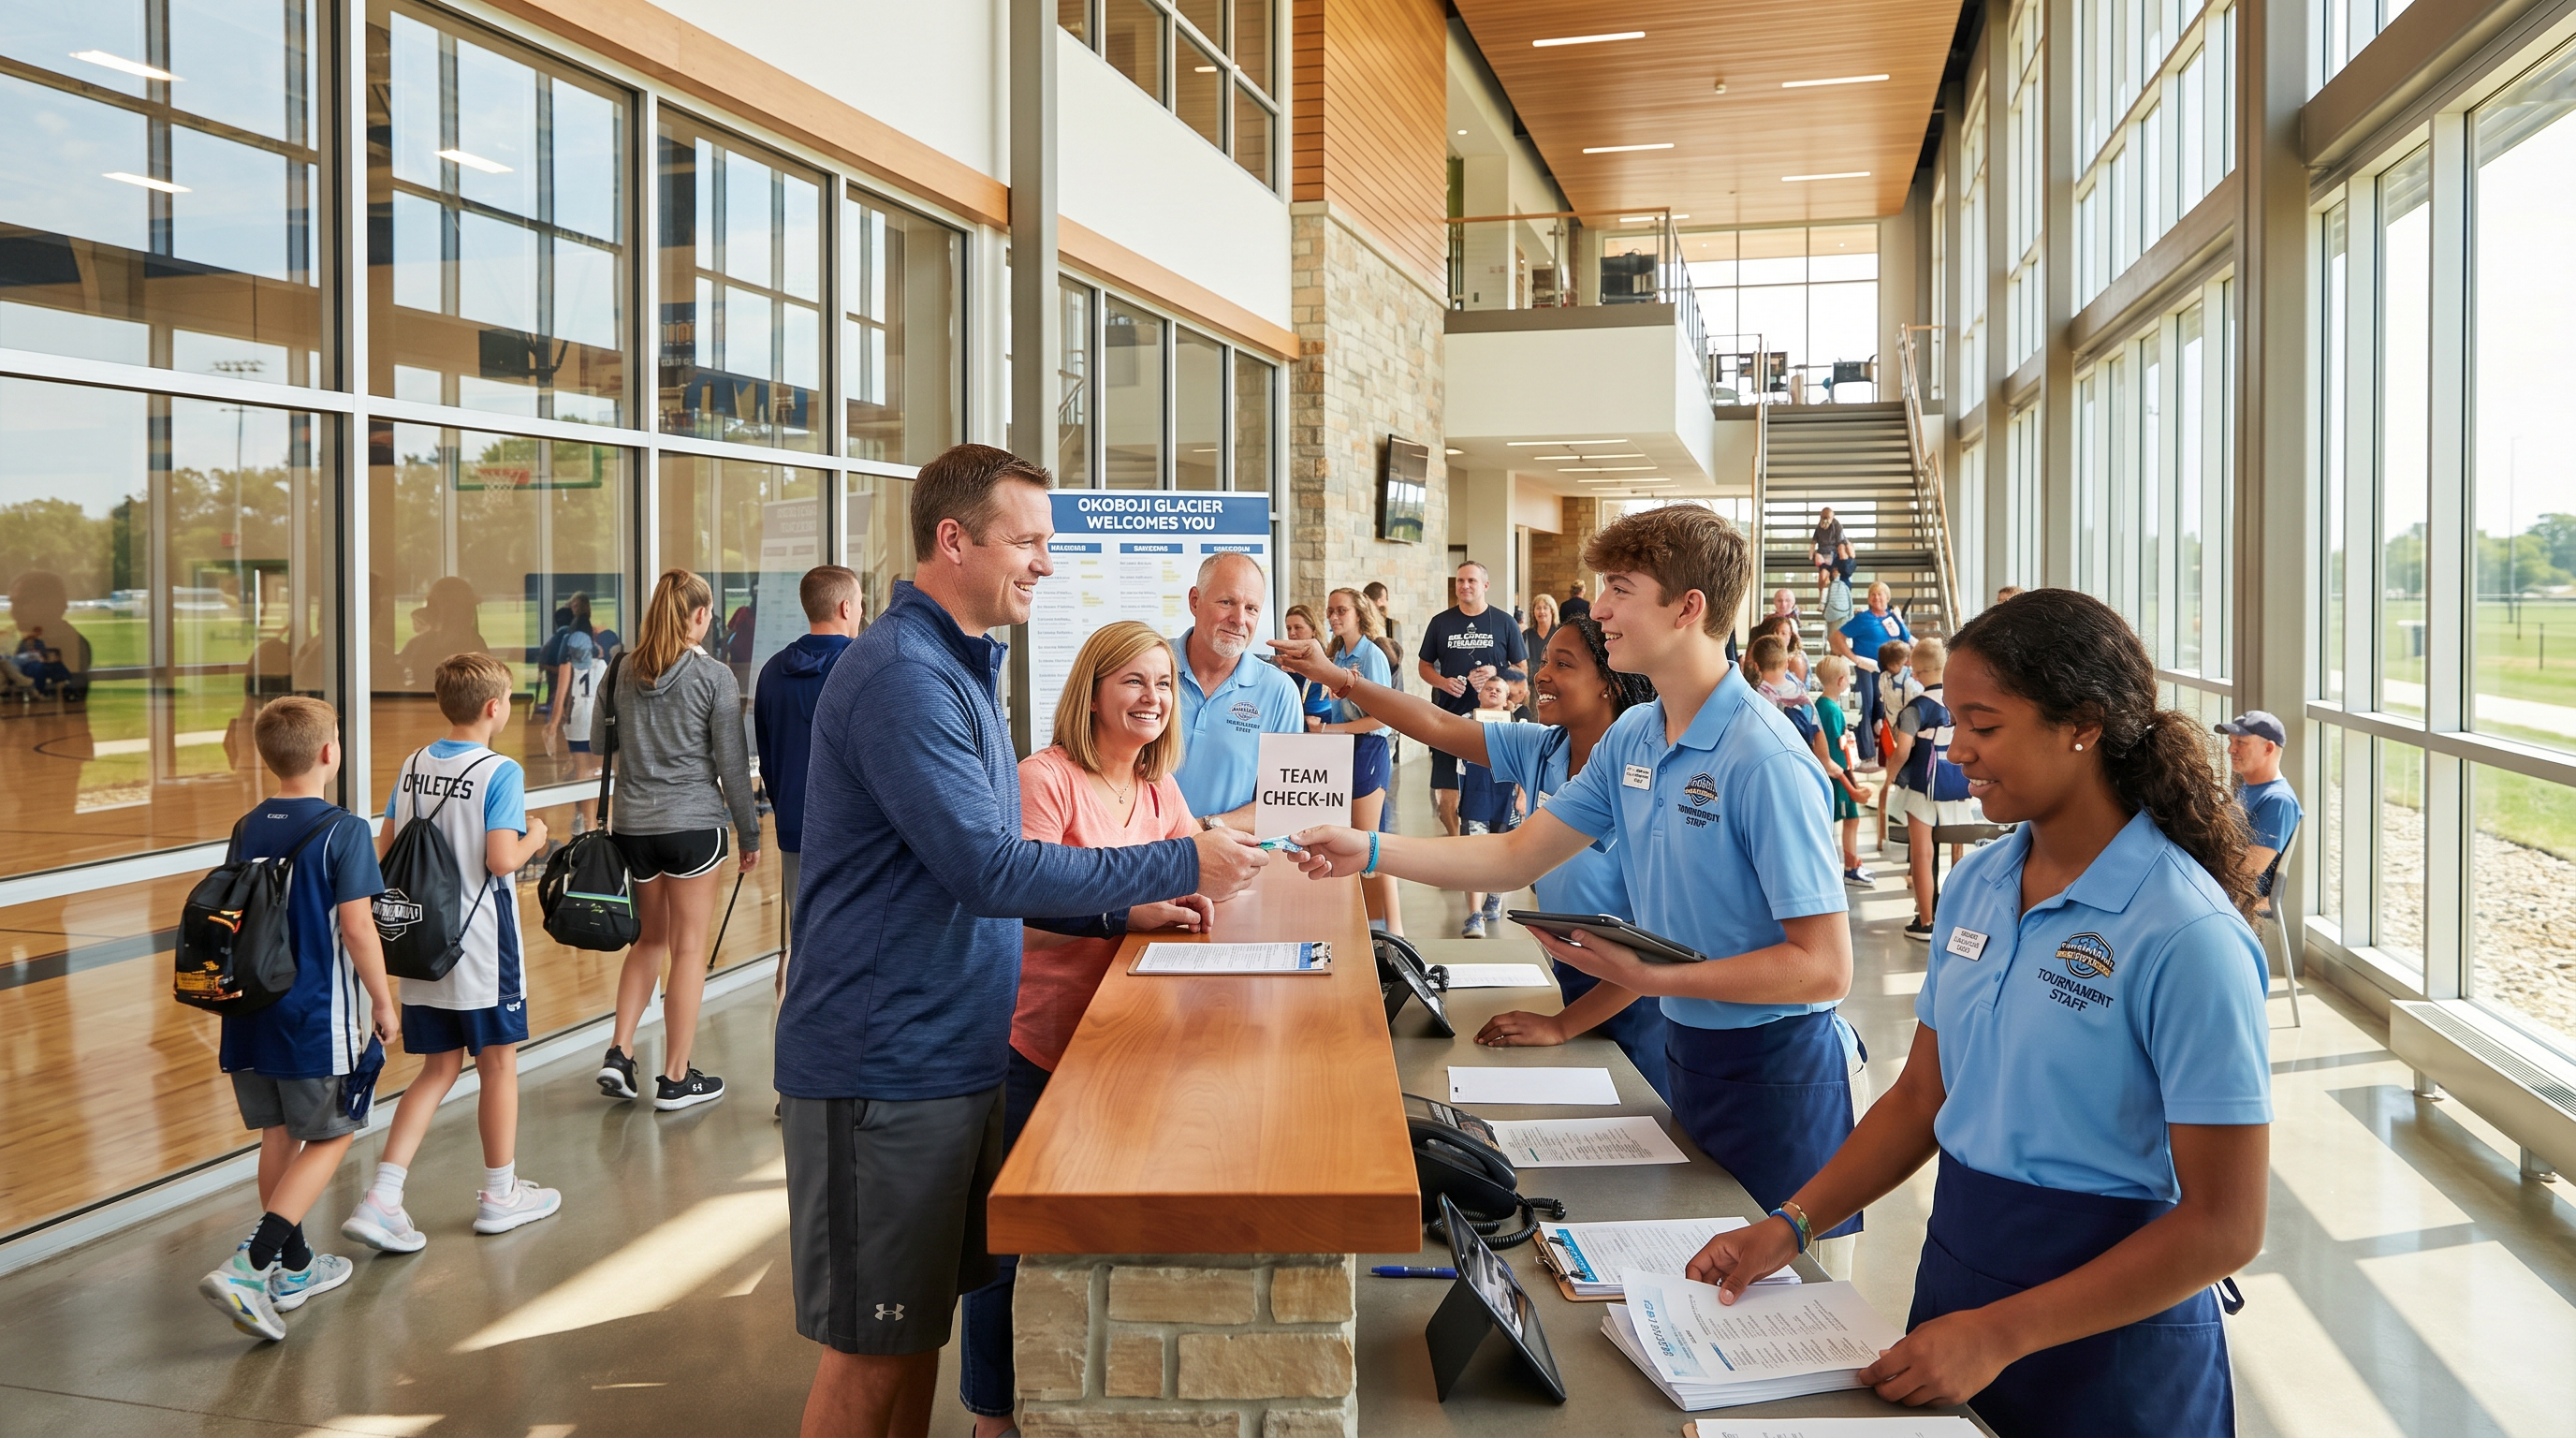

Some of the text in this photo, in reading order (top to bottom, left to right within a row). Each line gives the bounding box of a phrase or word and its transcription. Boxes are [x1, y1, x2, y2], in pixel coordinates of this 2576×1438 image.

[1077, 497, 1223, 514] OKOBOJI GLACIER
[1086, 515, 1216, 530] WELCOMES YOU
[1280, 769, 1328, 784] TEAM
[1263, 790, 1344, 807] CHECK-IN
[2037, 968, 2114, 1008] TOURNAMENT
[2049, 989, 2088, 1012] STAFF
